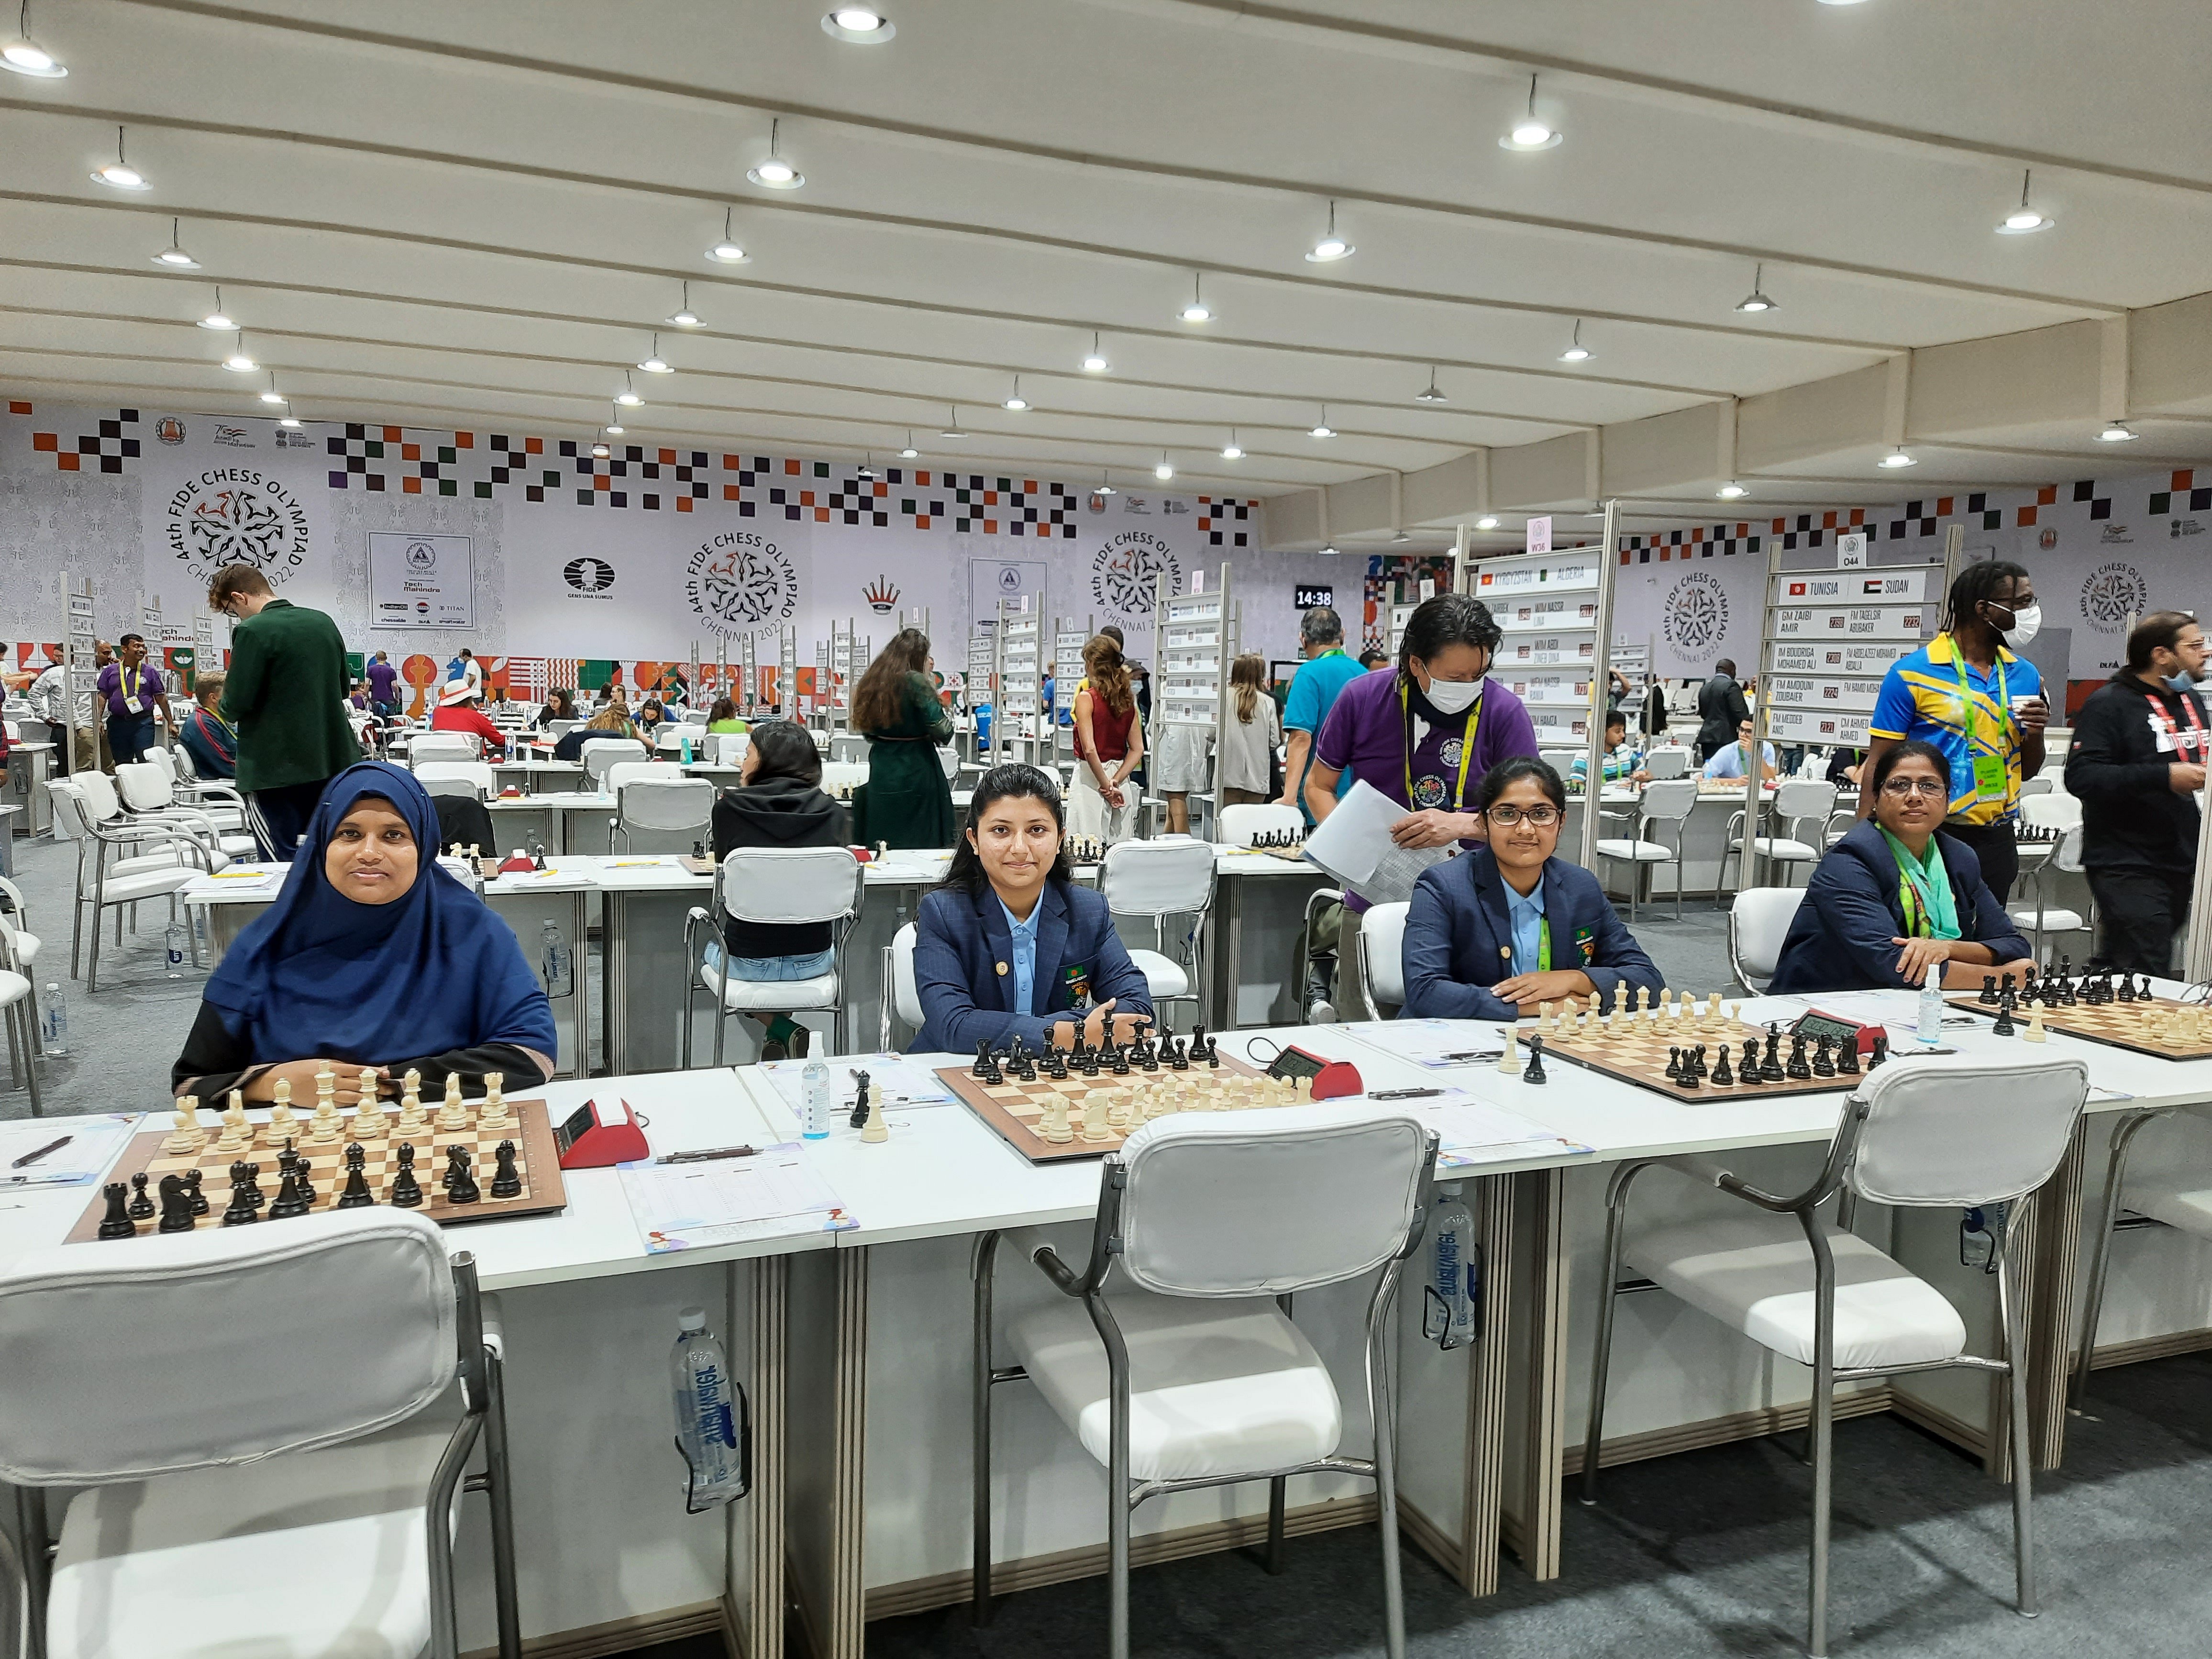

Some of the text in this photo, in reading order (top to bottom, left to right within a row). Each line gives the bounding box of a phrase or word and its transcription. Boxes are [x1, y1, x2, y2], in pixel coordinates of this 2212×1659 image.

[166, 468, 308, 565] 44th FIDE CHESS OLYMPIAD
[1531, 543, 1545, 553] W36
[1091, 531, 1182, 605] 44th FIDE CHESS OLYMPIA
[2098, 563, 2127, 574] CHESS
[268, 566, 295, 587] 022
[686, 532, 797, 618] 44th FIDE CHESS OLYMPIAD
[1494, 566, 1584, 586] KYRGYZSTAN ALGERIA
[1810, 579, 1909, 596] TUNISIA SUDAN
[1297, 591, 1331, 606] 14:38
[1665, 585, 1680, 611] FIDE
[1681, 572, 1710, 587] CHESS
[1710, 578, 1728, 641] OLYMPIAD
[1103, 608, 1146, 632] CHENNAI
[1781, 610, 1812, 621] GM ZAIBI
[1781, 622, 1799, 632] AMIR
[1904, 617, 1920, 628] 2232
[758, 619, 785, 640] 2022
[1777, 659, 1806, 670] MOHAMED
[1777, 680, 1786, 690] FM
[1773, 713, 1781, 723] FM
[1850, 719, 1869, 729] AHMED
[1821, 721, 1835, 733] 2121
[1840, 730, 1858, 741] AHMED
